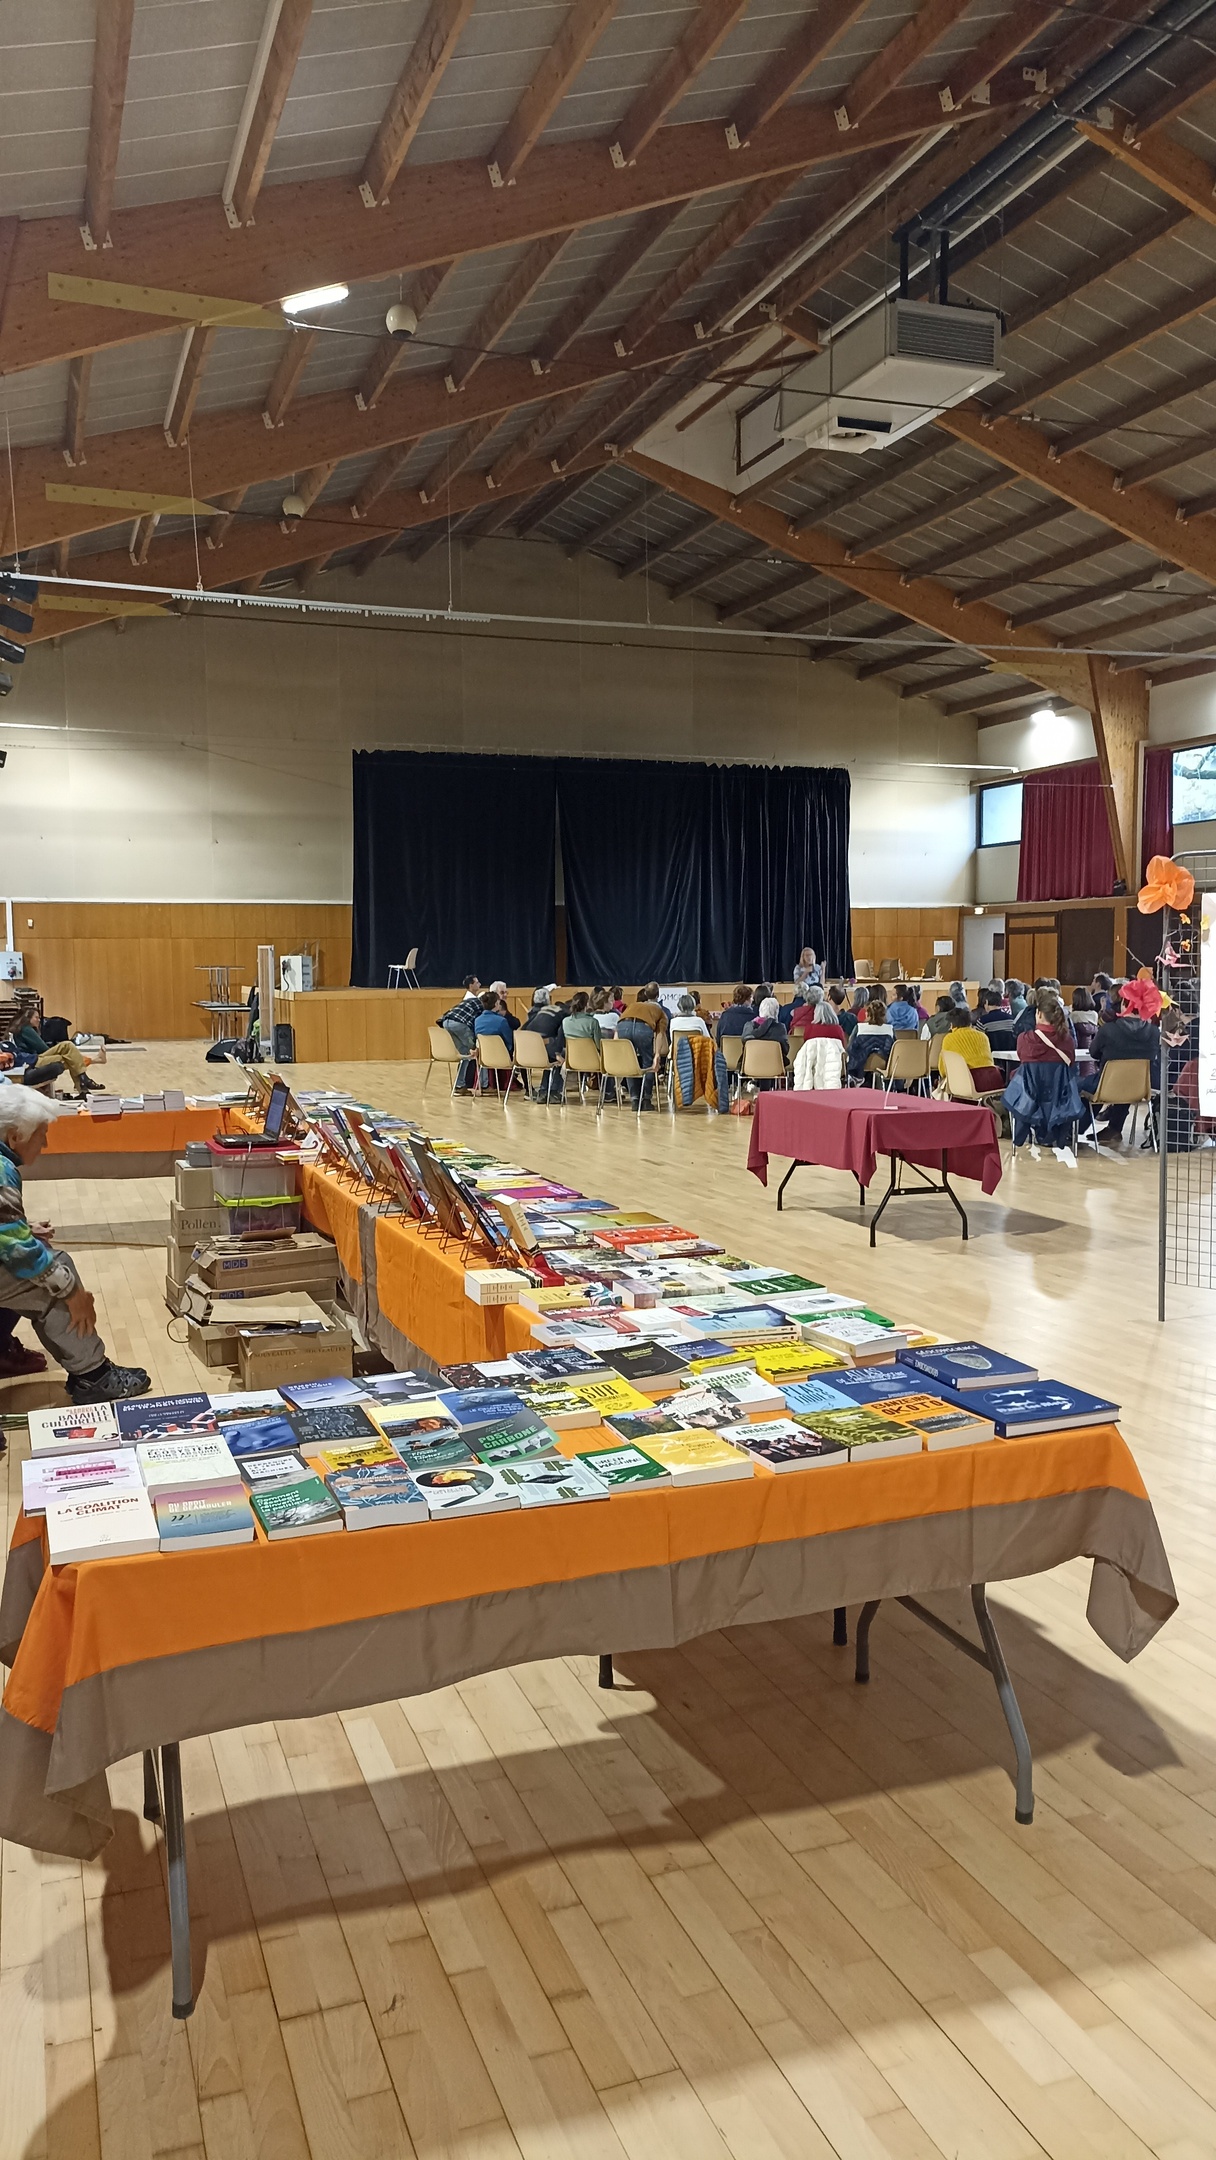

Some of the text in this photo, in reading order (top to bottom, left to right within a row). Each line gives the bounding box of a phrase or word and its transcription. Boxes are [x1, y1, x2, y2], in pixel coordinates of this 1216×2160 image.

[181, 1219, 221, 1230] Pollen.
[223, 1259, 247, 1269] MDS
[580, 1383, 619, 1399] SUR
[94, 1404, 107, 1412] LA
[58, 1410, 107, 1421] BATAILLE
[41, 1415, 108, 1429] CULTURELLE
[478, 1431, 509, 1444] POST
[484, 1425, 538, 1449] CARBONE
[256, 1490, 299, 1502] Comment
[75, 1498, 139, 1511] COALITION
[76, 1505, 121, 1516] CLIMAT
